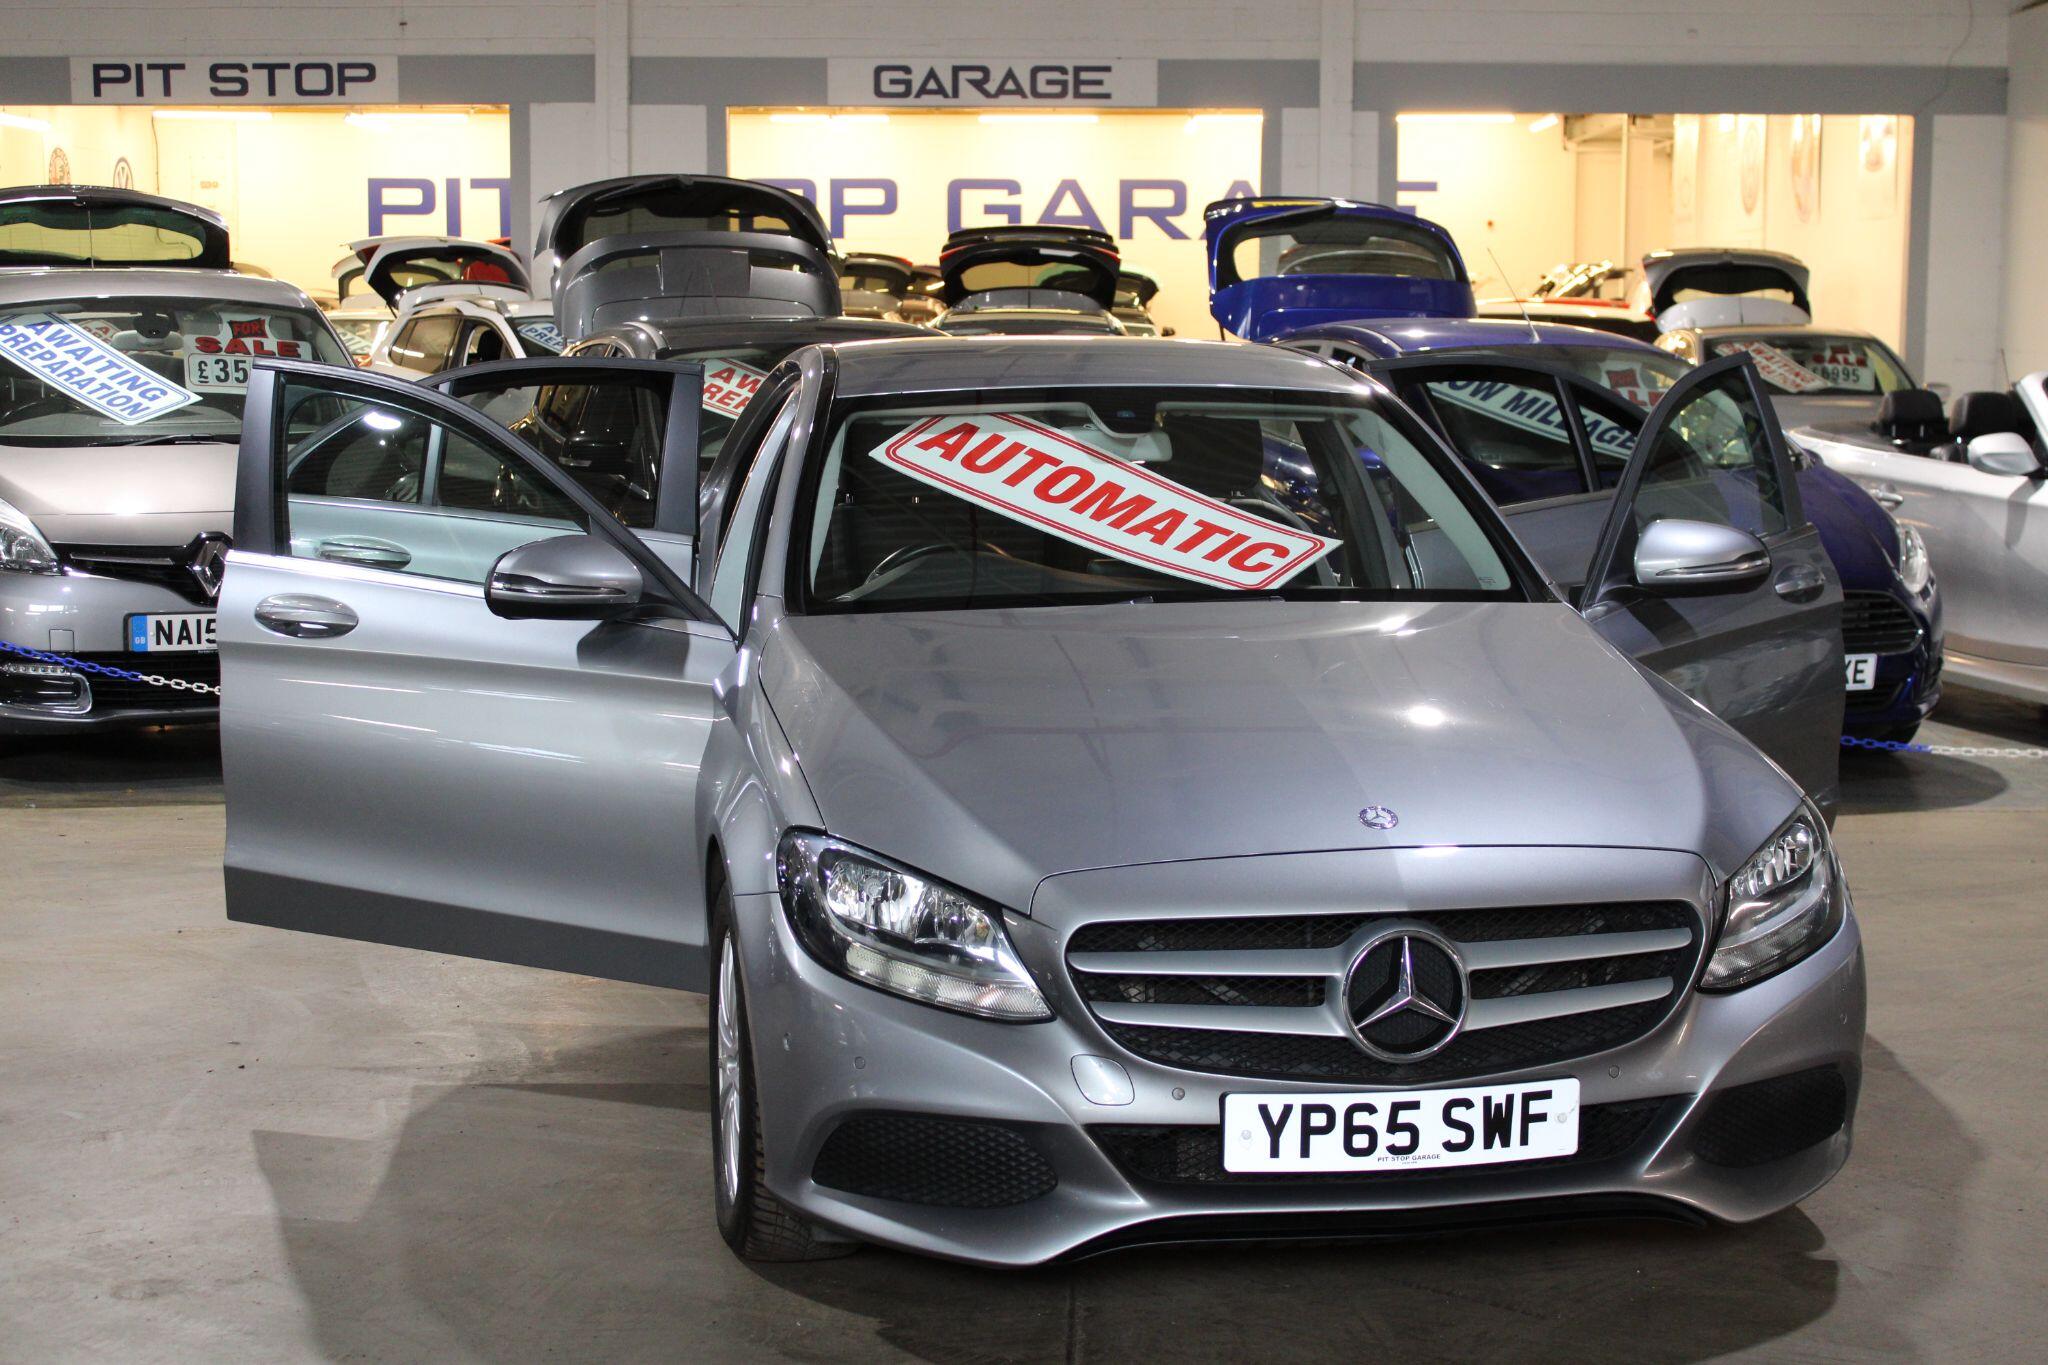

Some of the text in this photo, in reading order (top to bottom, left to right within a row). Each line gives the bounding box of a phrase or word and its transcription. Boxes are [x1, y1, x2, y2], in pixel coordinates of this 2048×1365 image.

[92, 62, 377, 98] PIT STOP
[873, 64, 1112, 100] GARAGE
[232, 320, 262, 336] FOR
[25, 320, 168, 402] AWAITING
[194, 336, 301, 357] SALE
[0, 324, 151, 417] PREPARATION
[1446, 380, 1508, 401] OW
[916, 421, 1290, 573] AUTOMATIC
[1258, 1088, 1554, 1159] YP65 SWF
[1411, 1153, 1441, 1161] GARAGE
